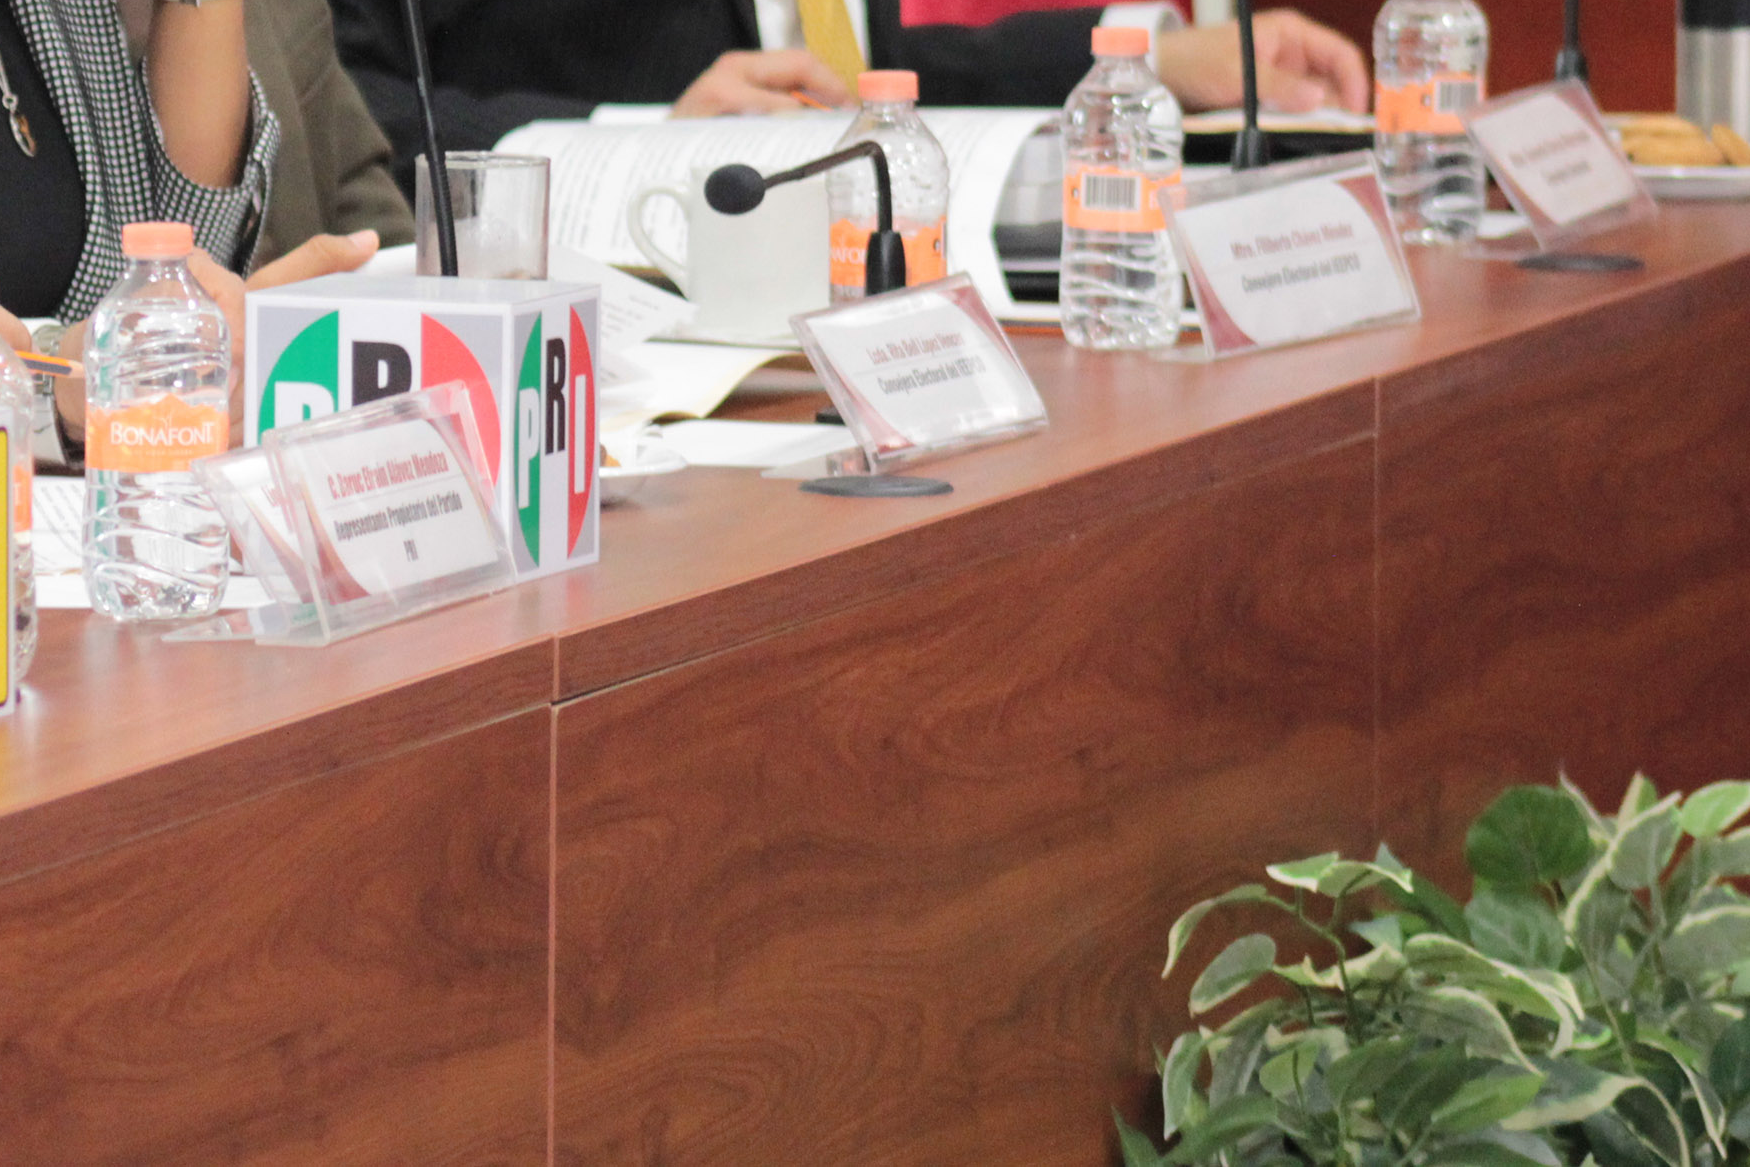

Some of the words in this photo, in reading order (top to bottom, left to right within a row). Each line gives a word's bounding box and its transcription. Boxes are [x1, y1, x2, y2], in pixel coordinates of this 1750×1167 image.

[912, 366, 948, 386] Electoral
[110, 421, 215, 446] BONAFONT
[517, 337, 587, 510] PRI
[411, 451, 449, 478] Mendoza
[334, 511, 389, 542] Representante
[426, 495, 440, 517] del
[437, 490, 463, 515] Partido
